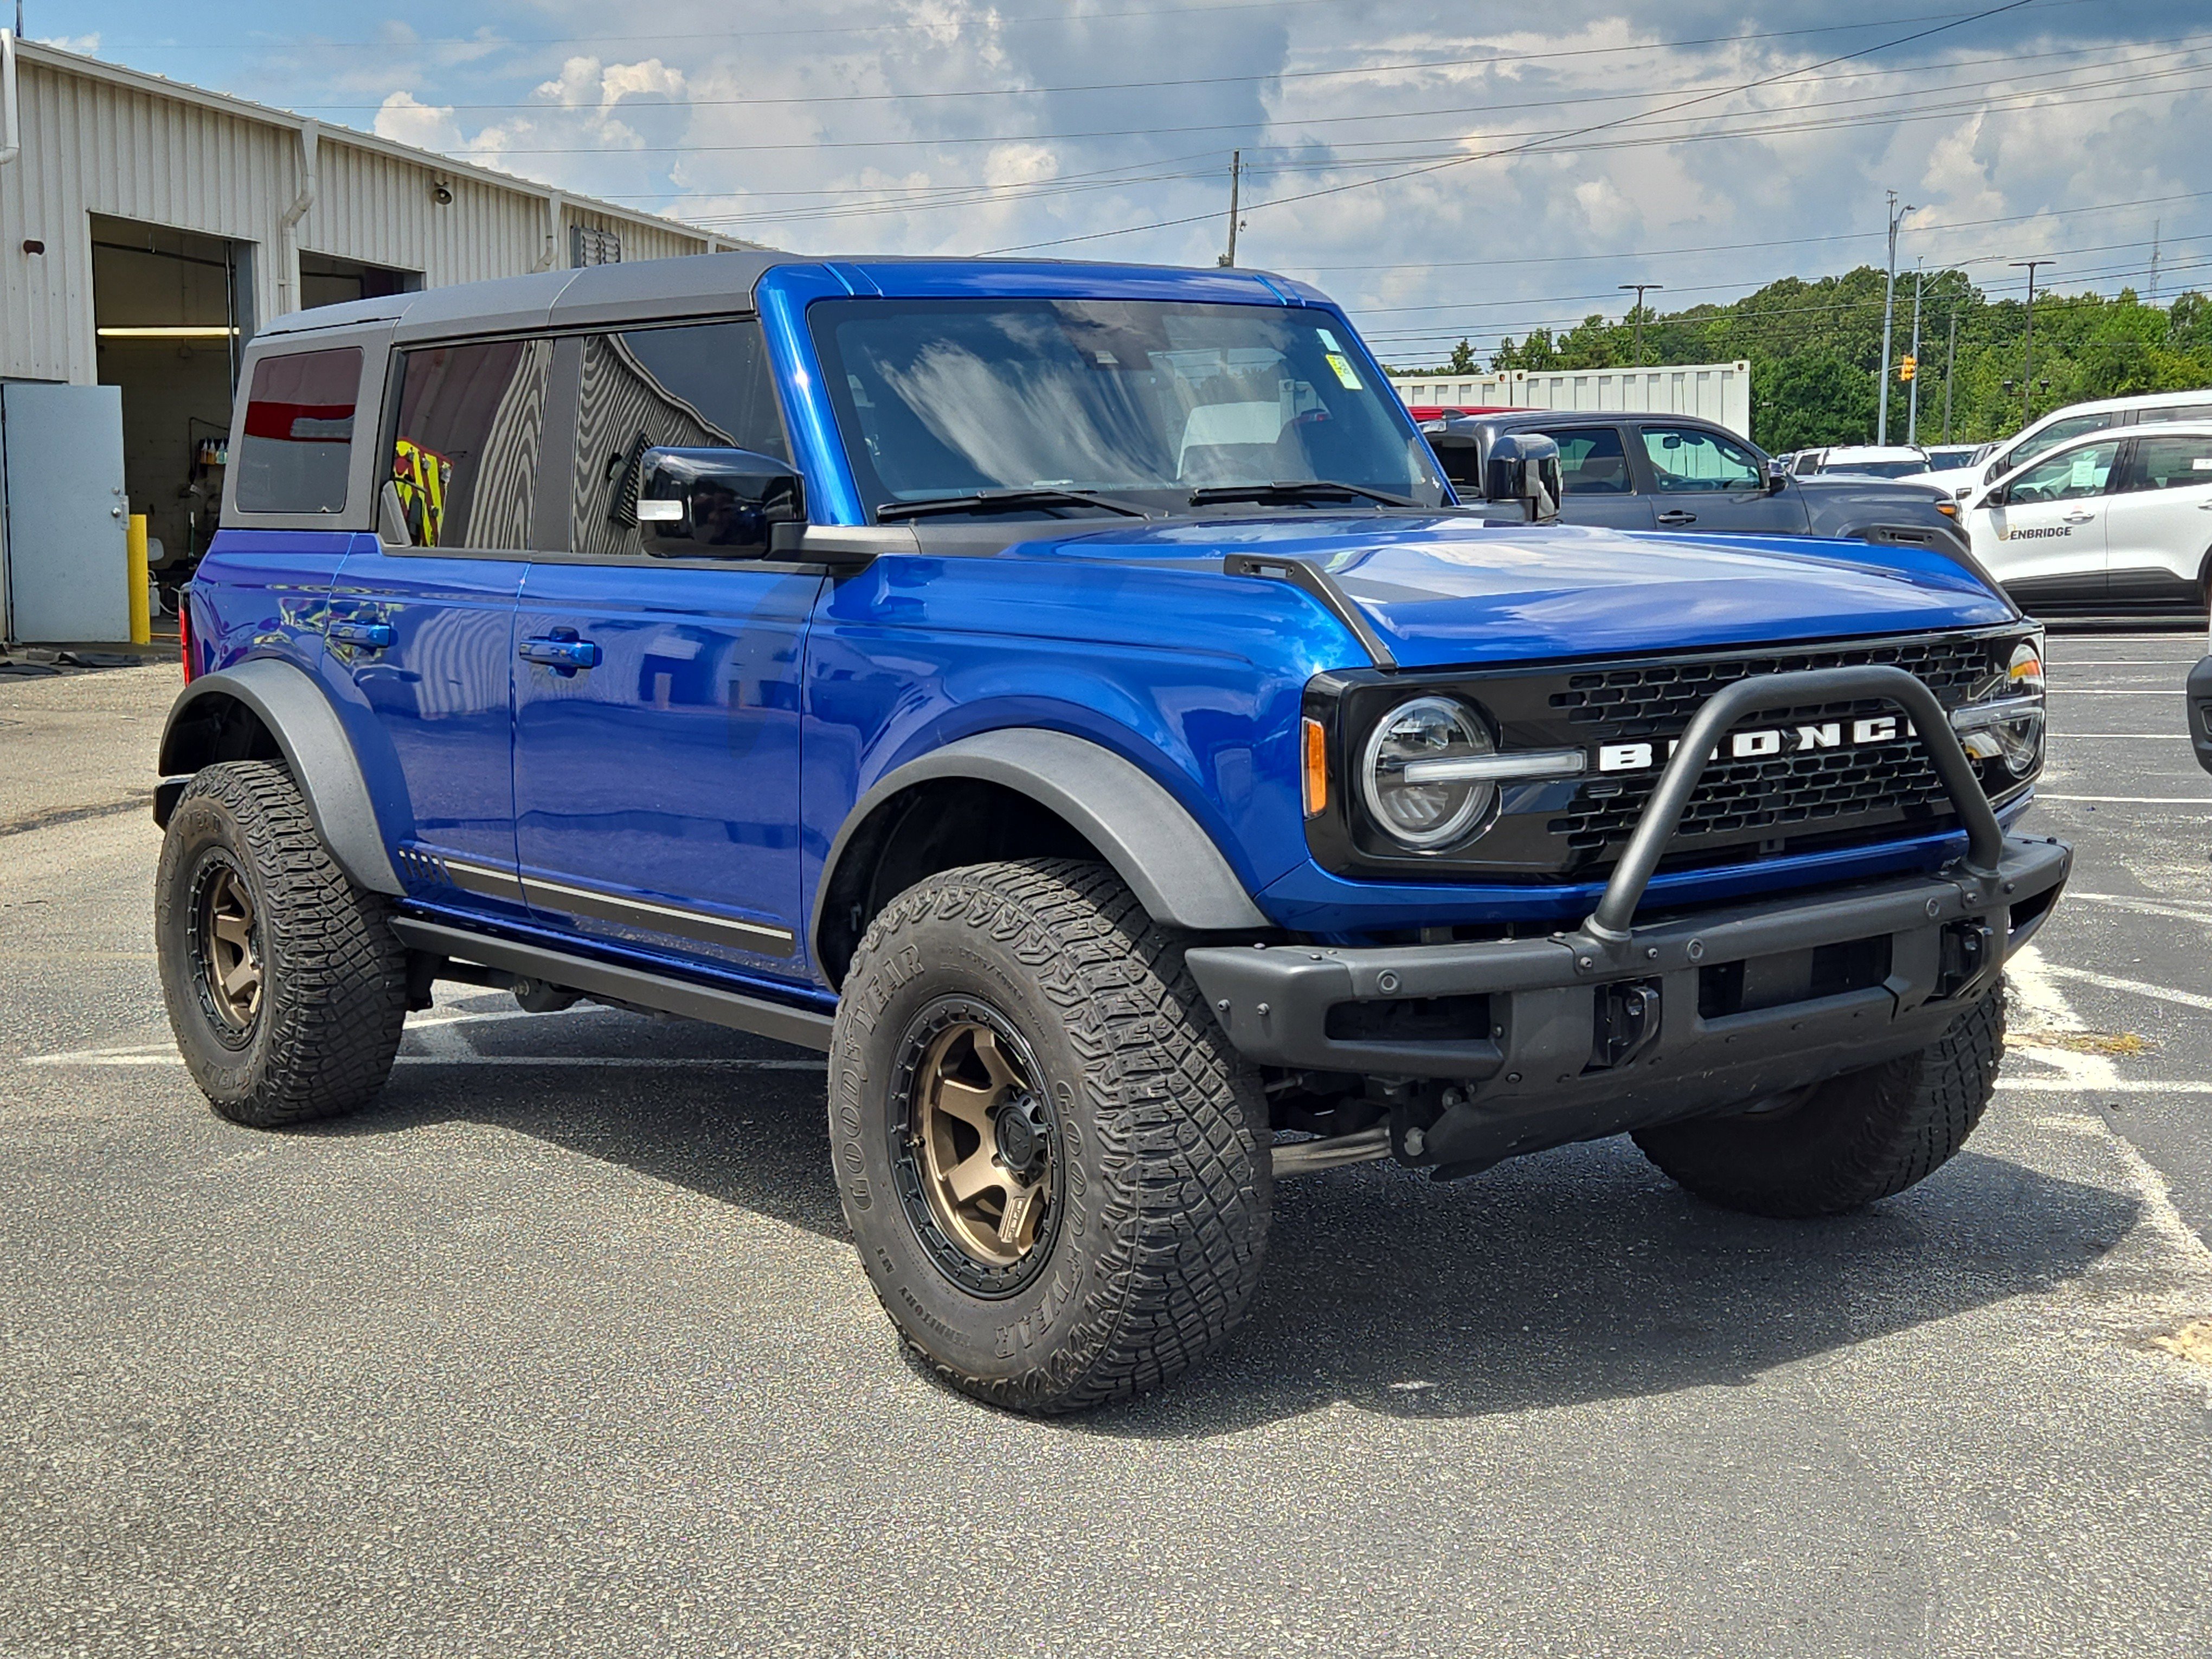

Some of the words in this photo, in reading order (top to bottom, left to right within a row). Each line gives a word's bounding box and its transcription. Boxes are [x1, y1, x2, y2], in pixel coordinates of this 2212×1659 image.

[2010, 526, 2073, 540] ENBRIDGE
[1599, 711, 1947, 772] BONC
[841, 943, 925, 1211] GOODYEAR
[994, 1079, 1086, 1359] GOODYEAR
